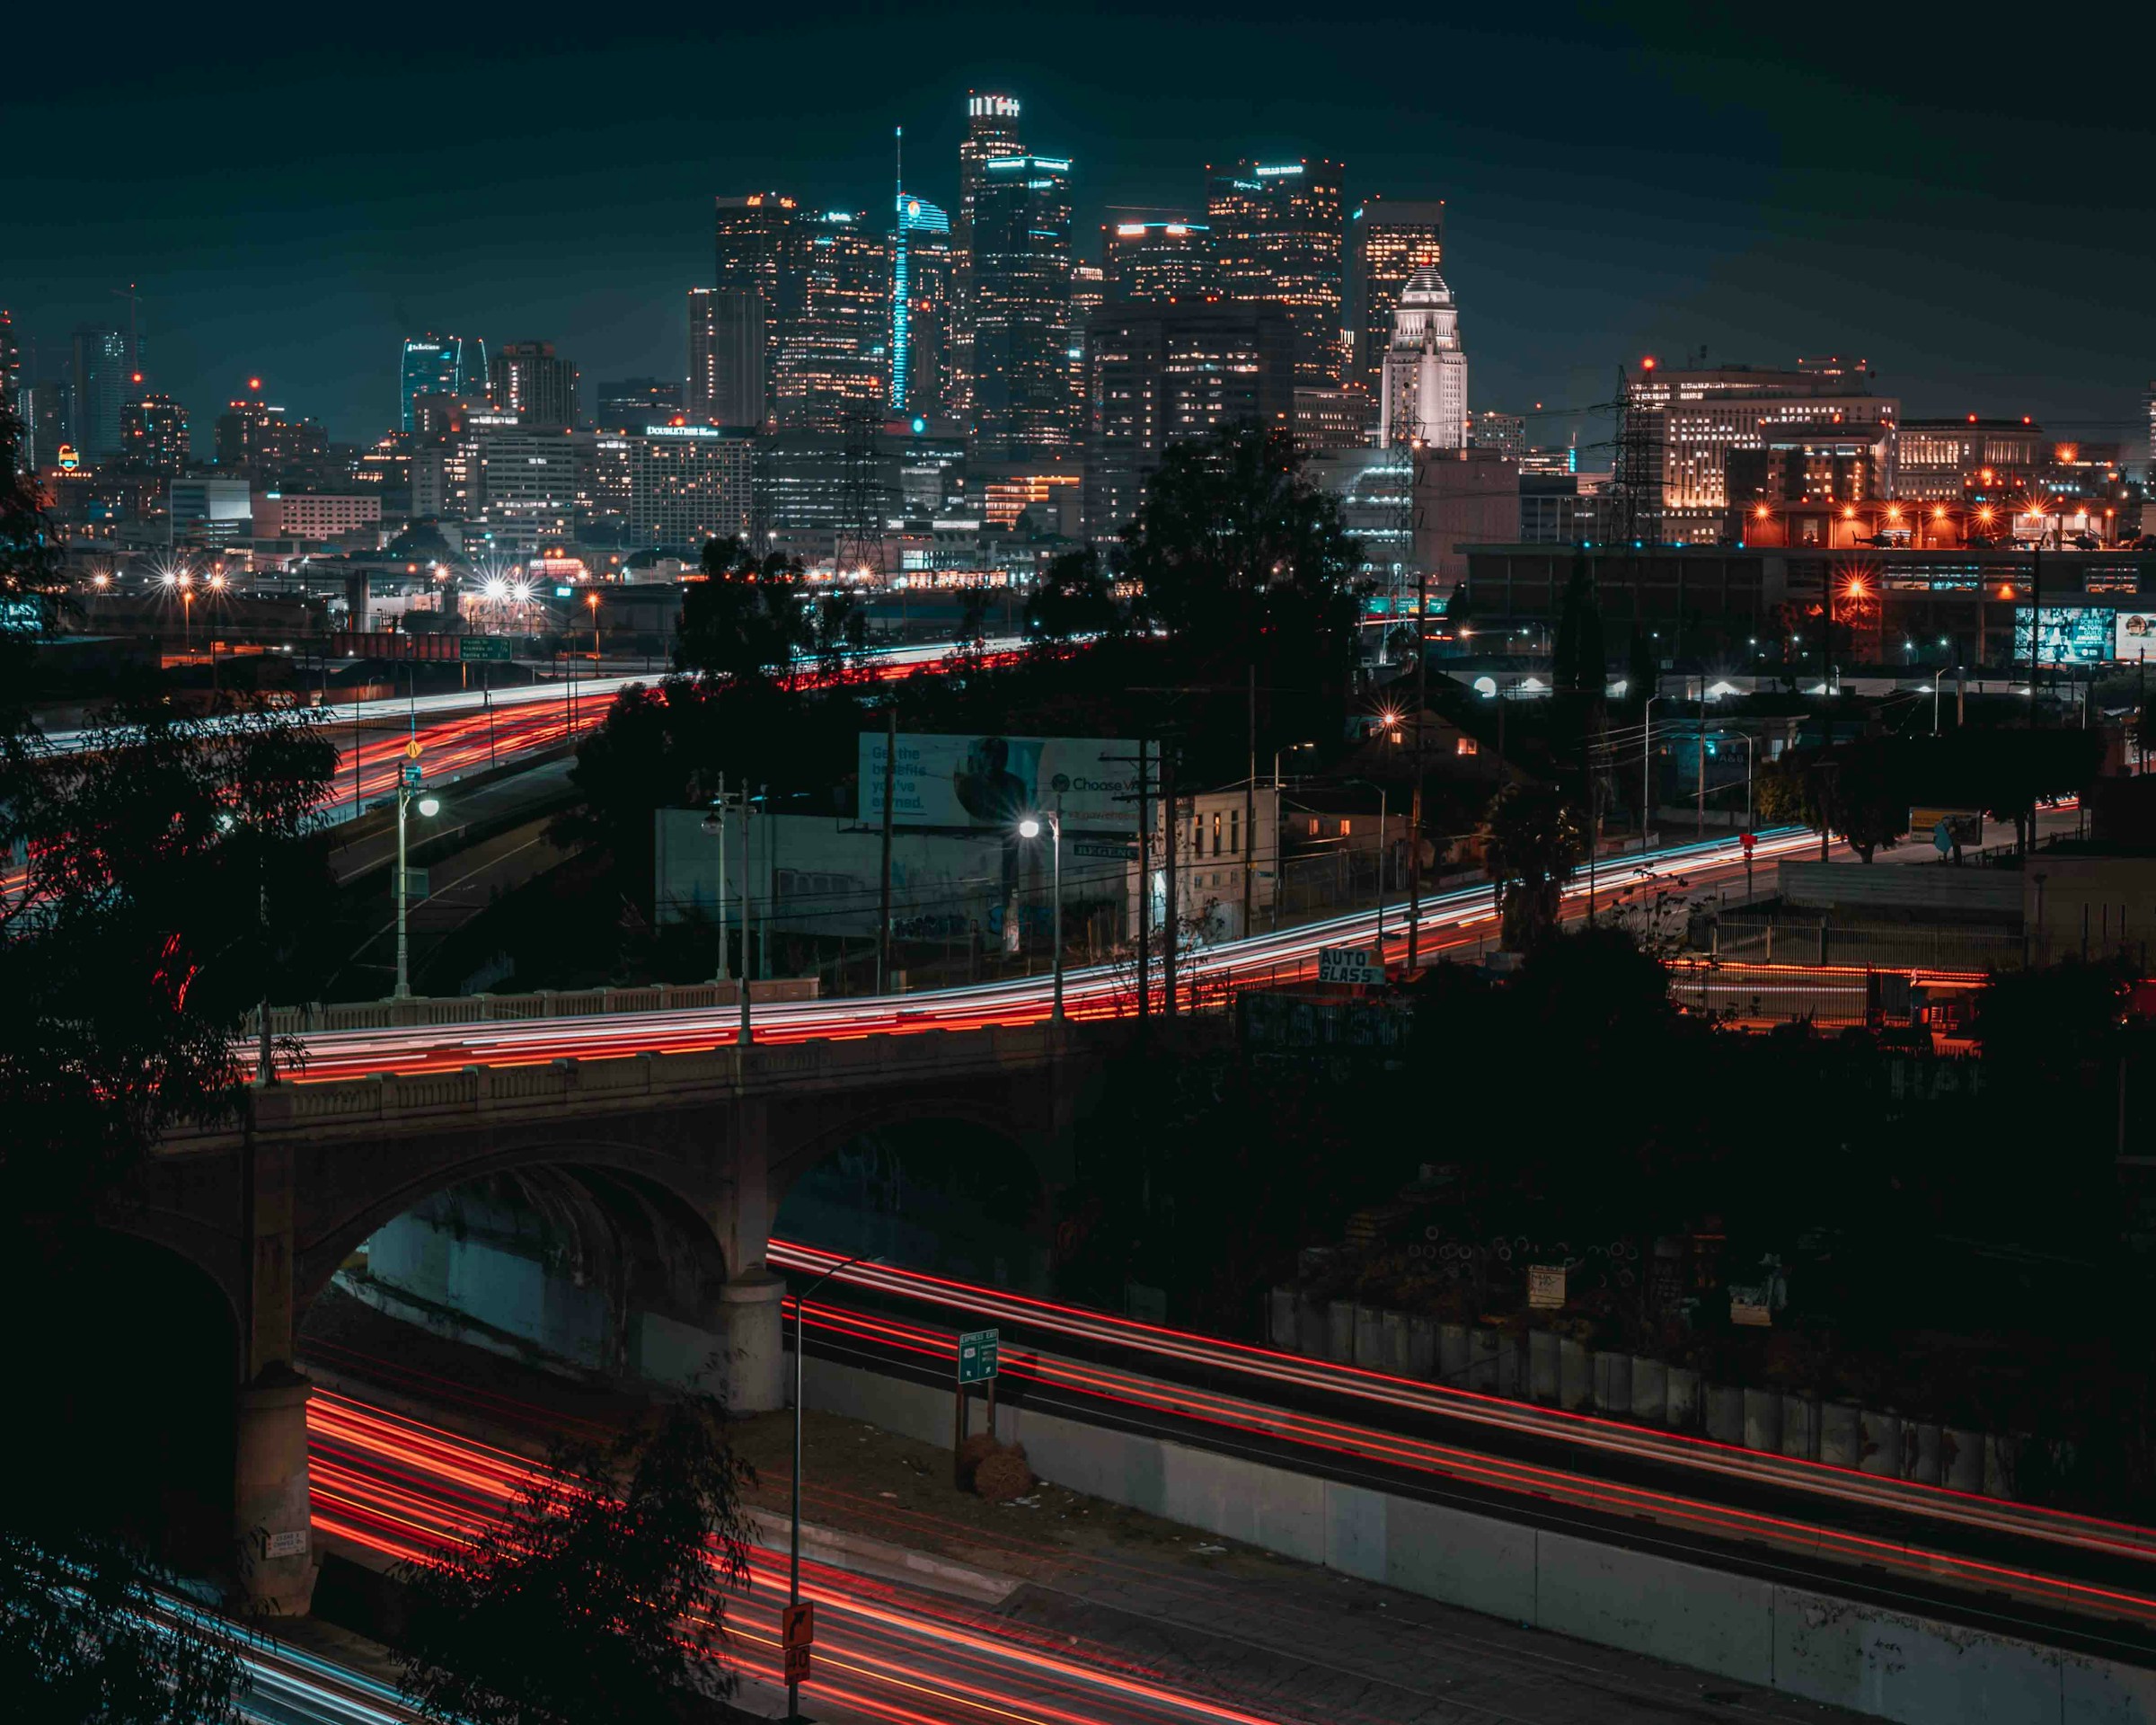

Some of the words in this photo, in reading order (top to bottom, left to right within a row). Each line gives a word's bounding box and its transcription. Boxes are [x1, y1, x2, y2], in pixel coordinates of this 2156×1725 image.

[872, 747, 891, 759] Ge
[898, 748, 920, 760] the
[1074, 777, 1122, 791] Choose
[1321, 951, 1366, 967] AUTO
[1320, 966, 1373, 983] GLASS
